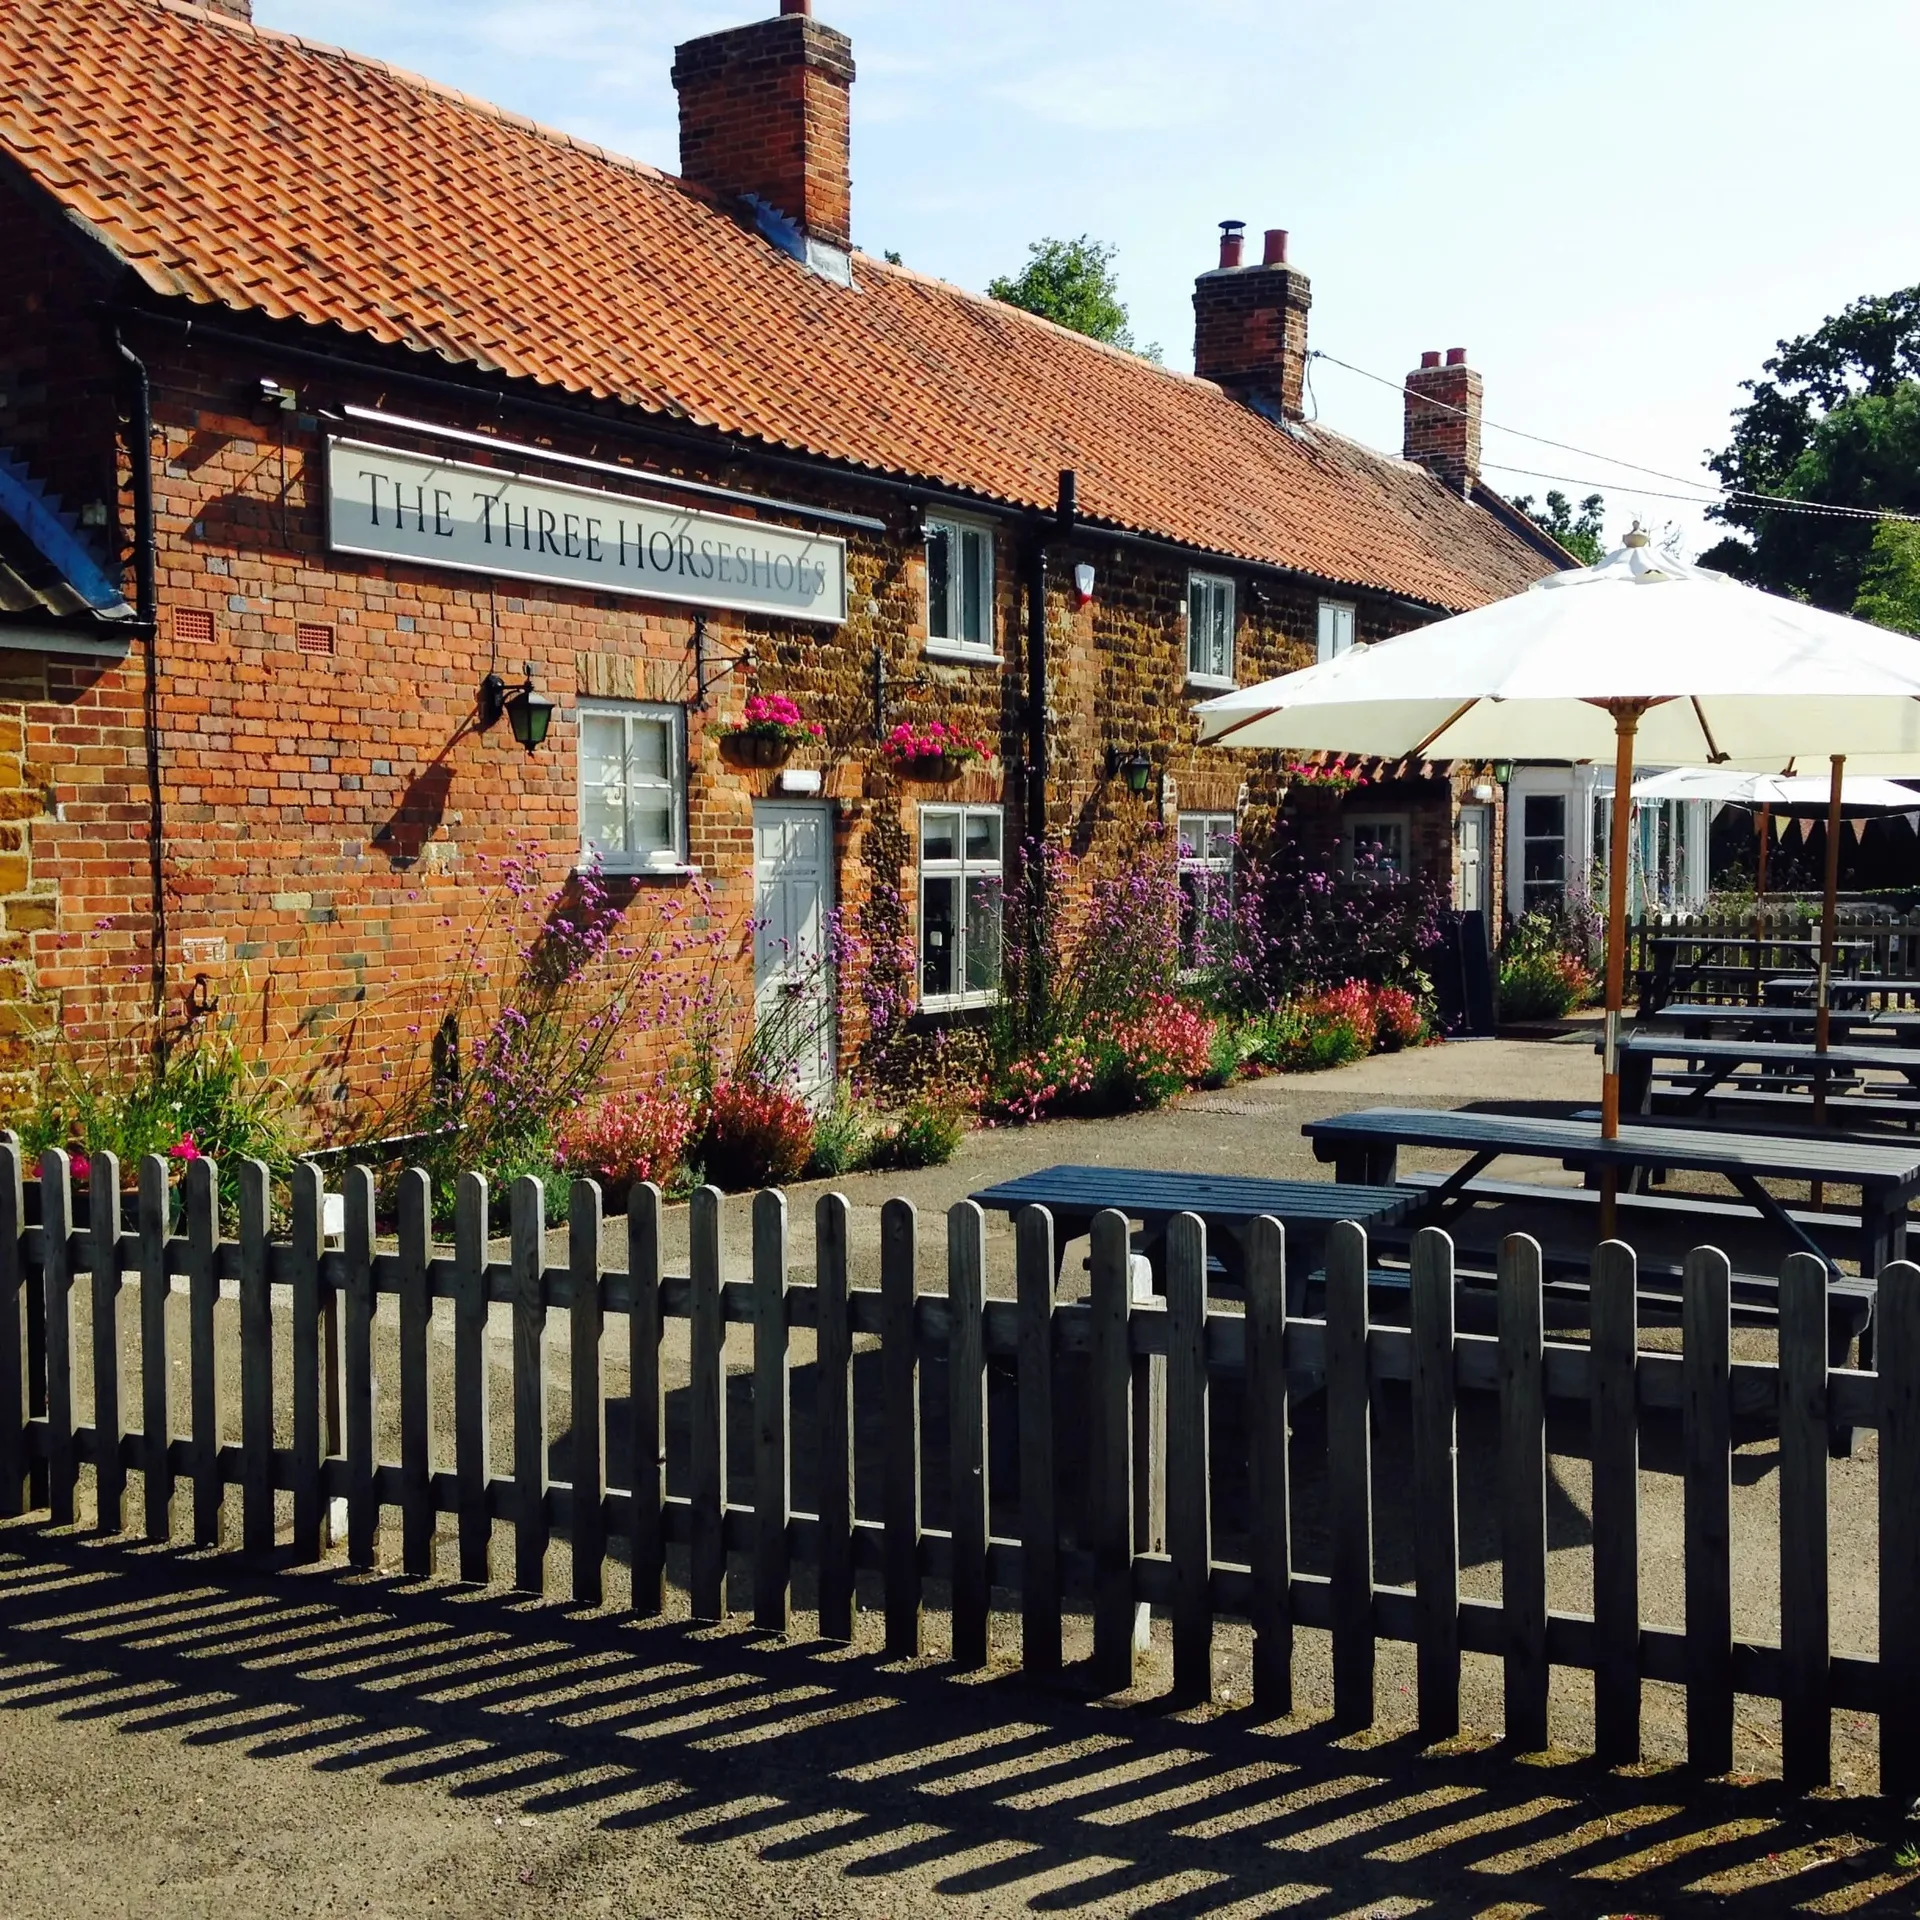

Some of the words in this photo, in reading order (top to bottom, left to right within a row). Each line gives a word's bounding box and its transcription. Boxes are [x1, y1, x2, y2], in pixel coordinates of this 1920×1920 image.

[358, 470, 454, 537] THE
[473, 492, 603, 562] THREE
[618, 519, 826, 597] HORSESHOES
